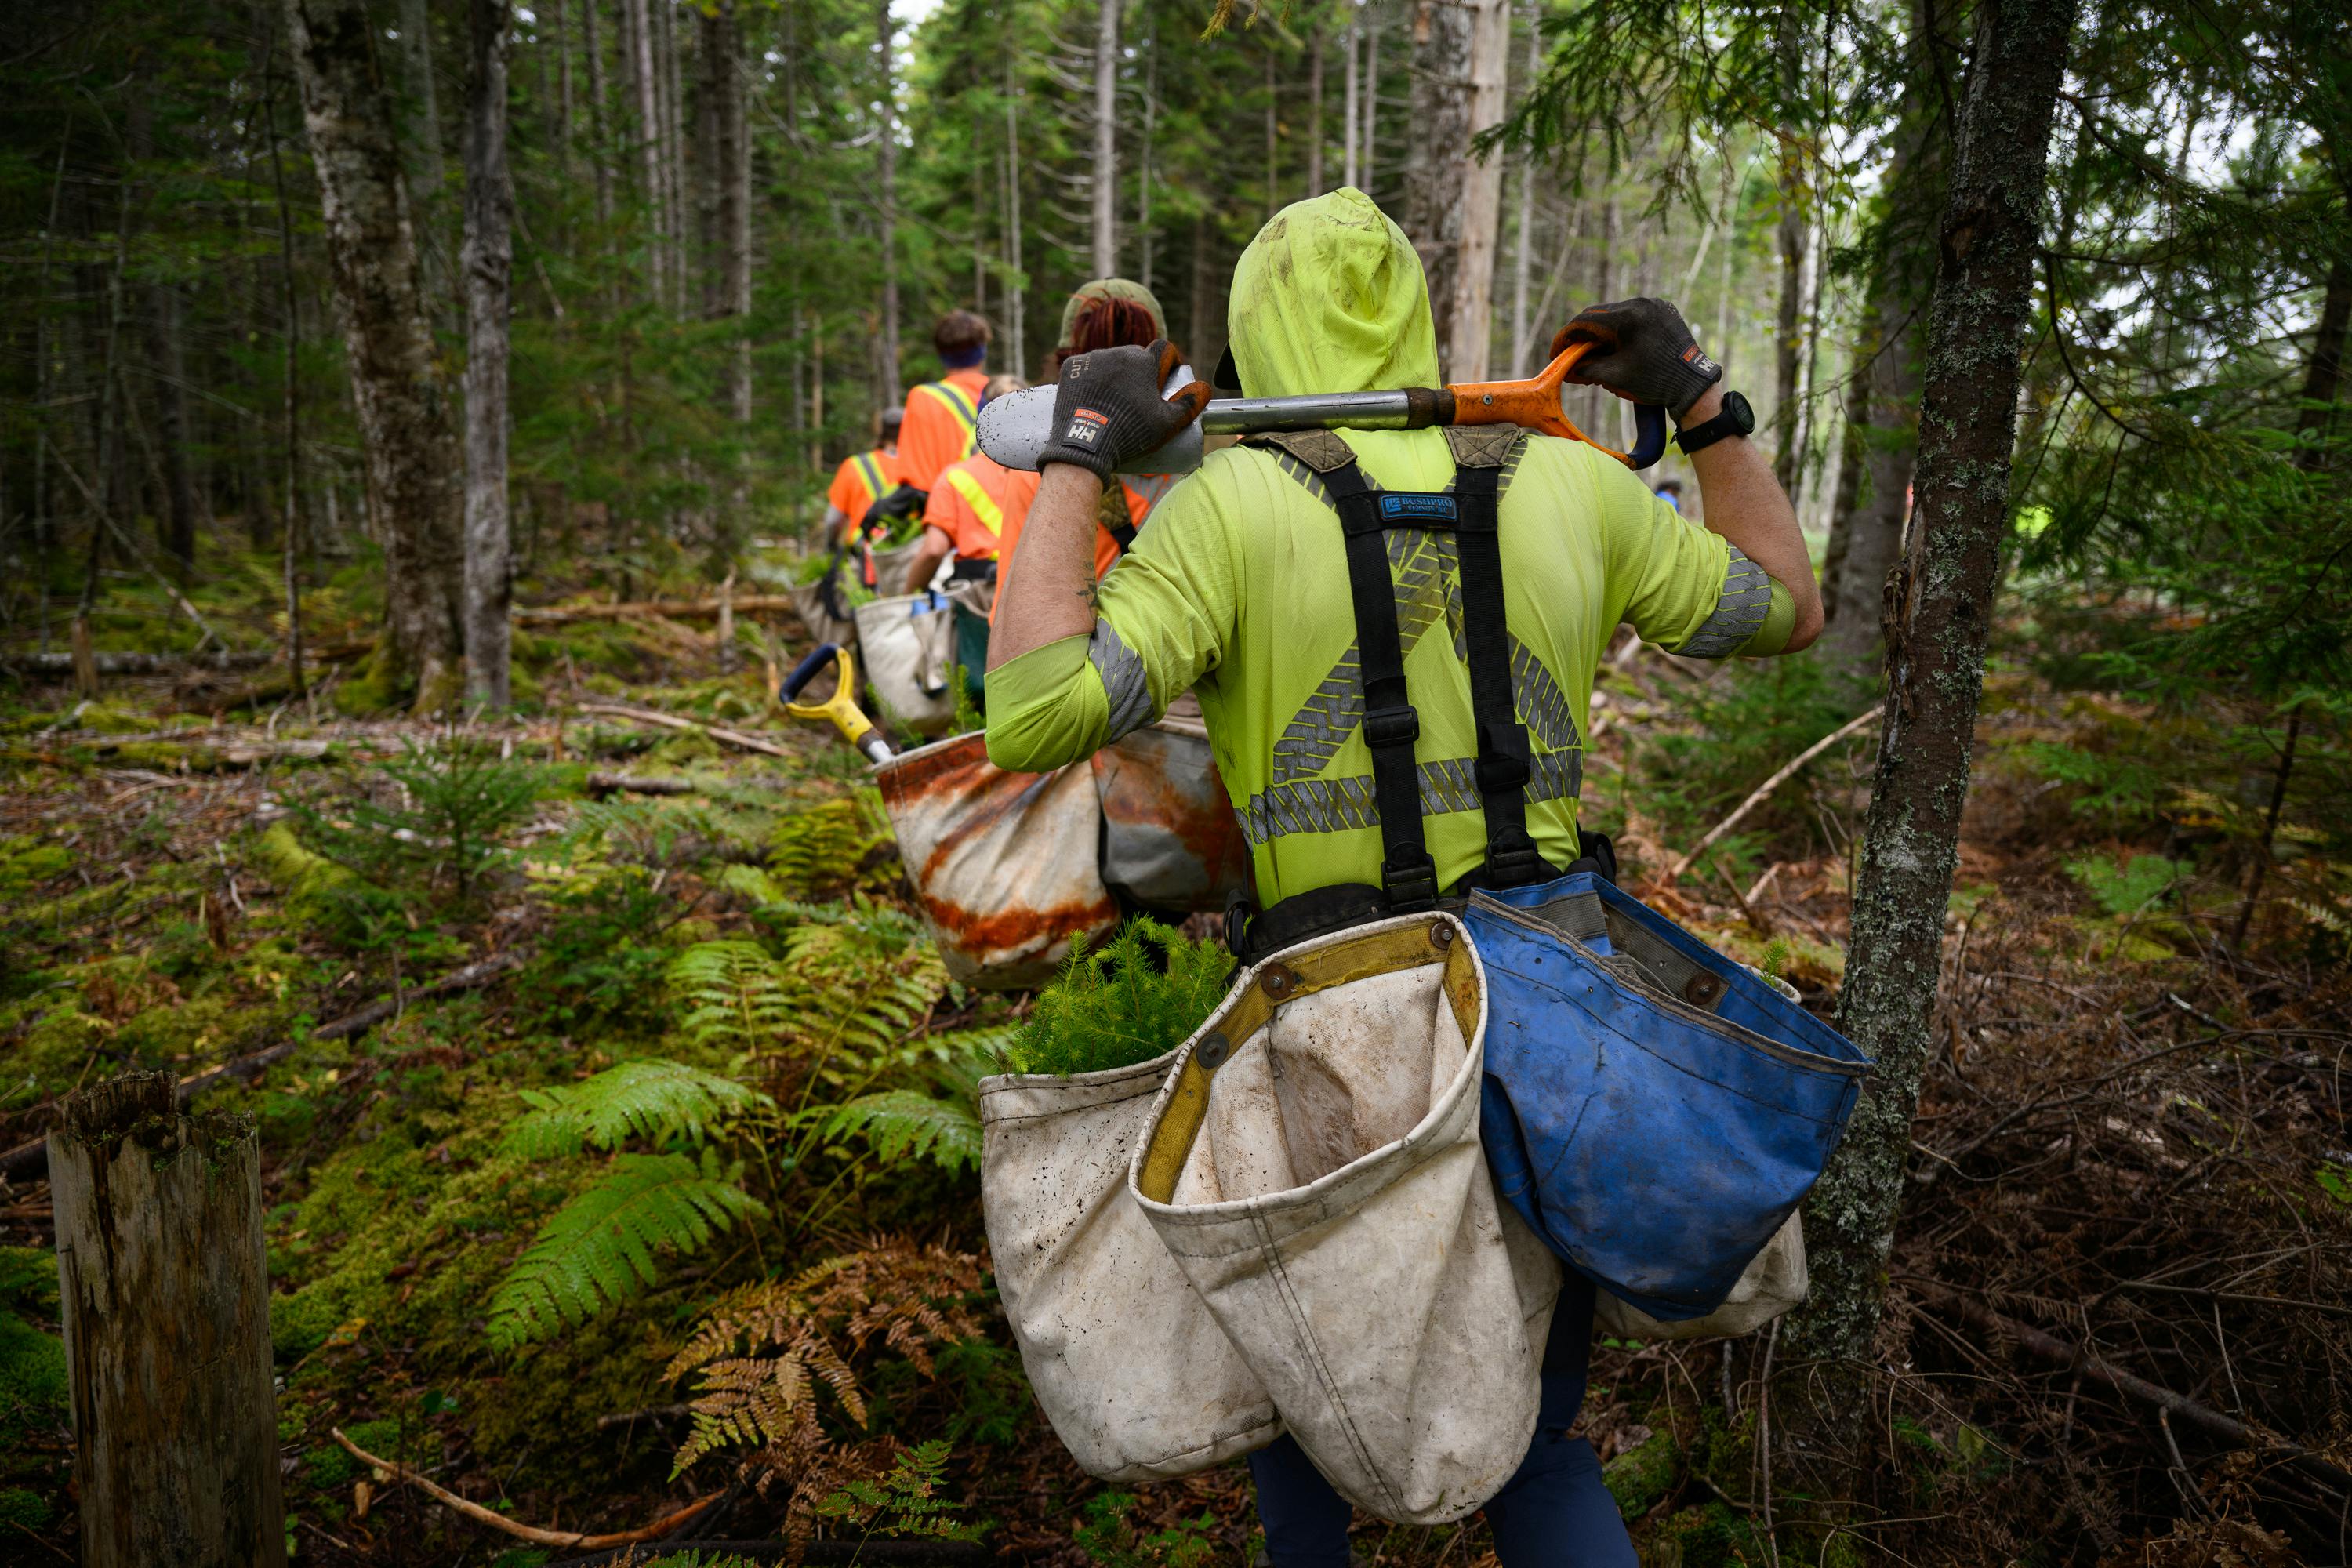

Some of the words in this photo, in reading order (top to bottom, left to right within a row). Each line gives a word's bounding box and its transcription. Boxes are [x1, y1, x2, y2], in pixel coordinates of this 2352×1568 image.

[1069, 358, 1083, 379] CUT
[1067, 424, 1097, 444] HH
[1402, 497, 1453, 508] BUSHPRO
